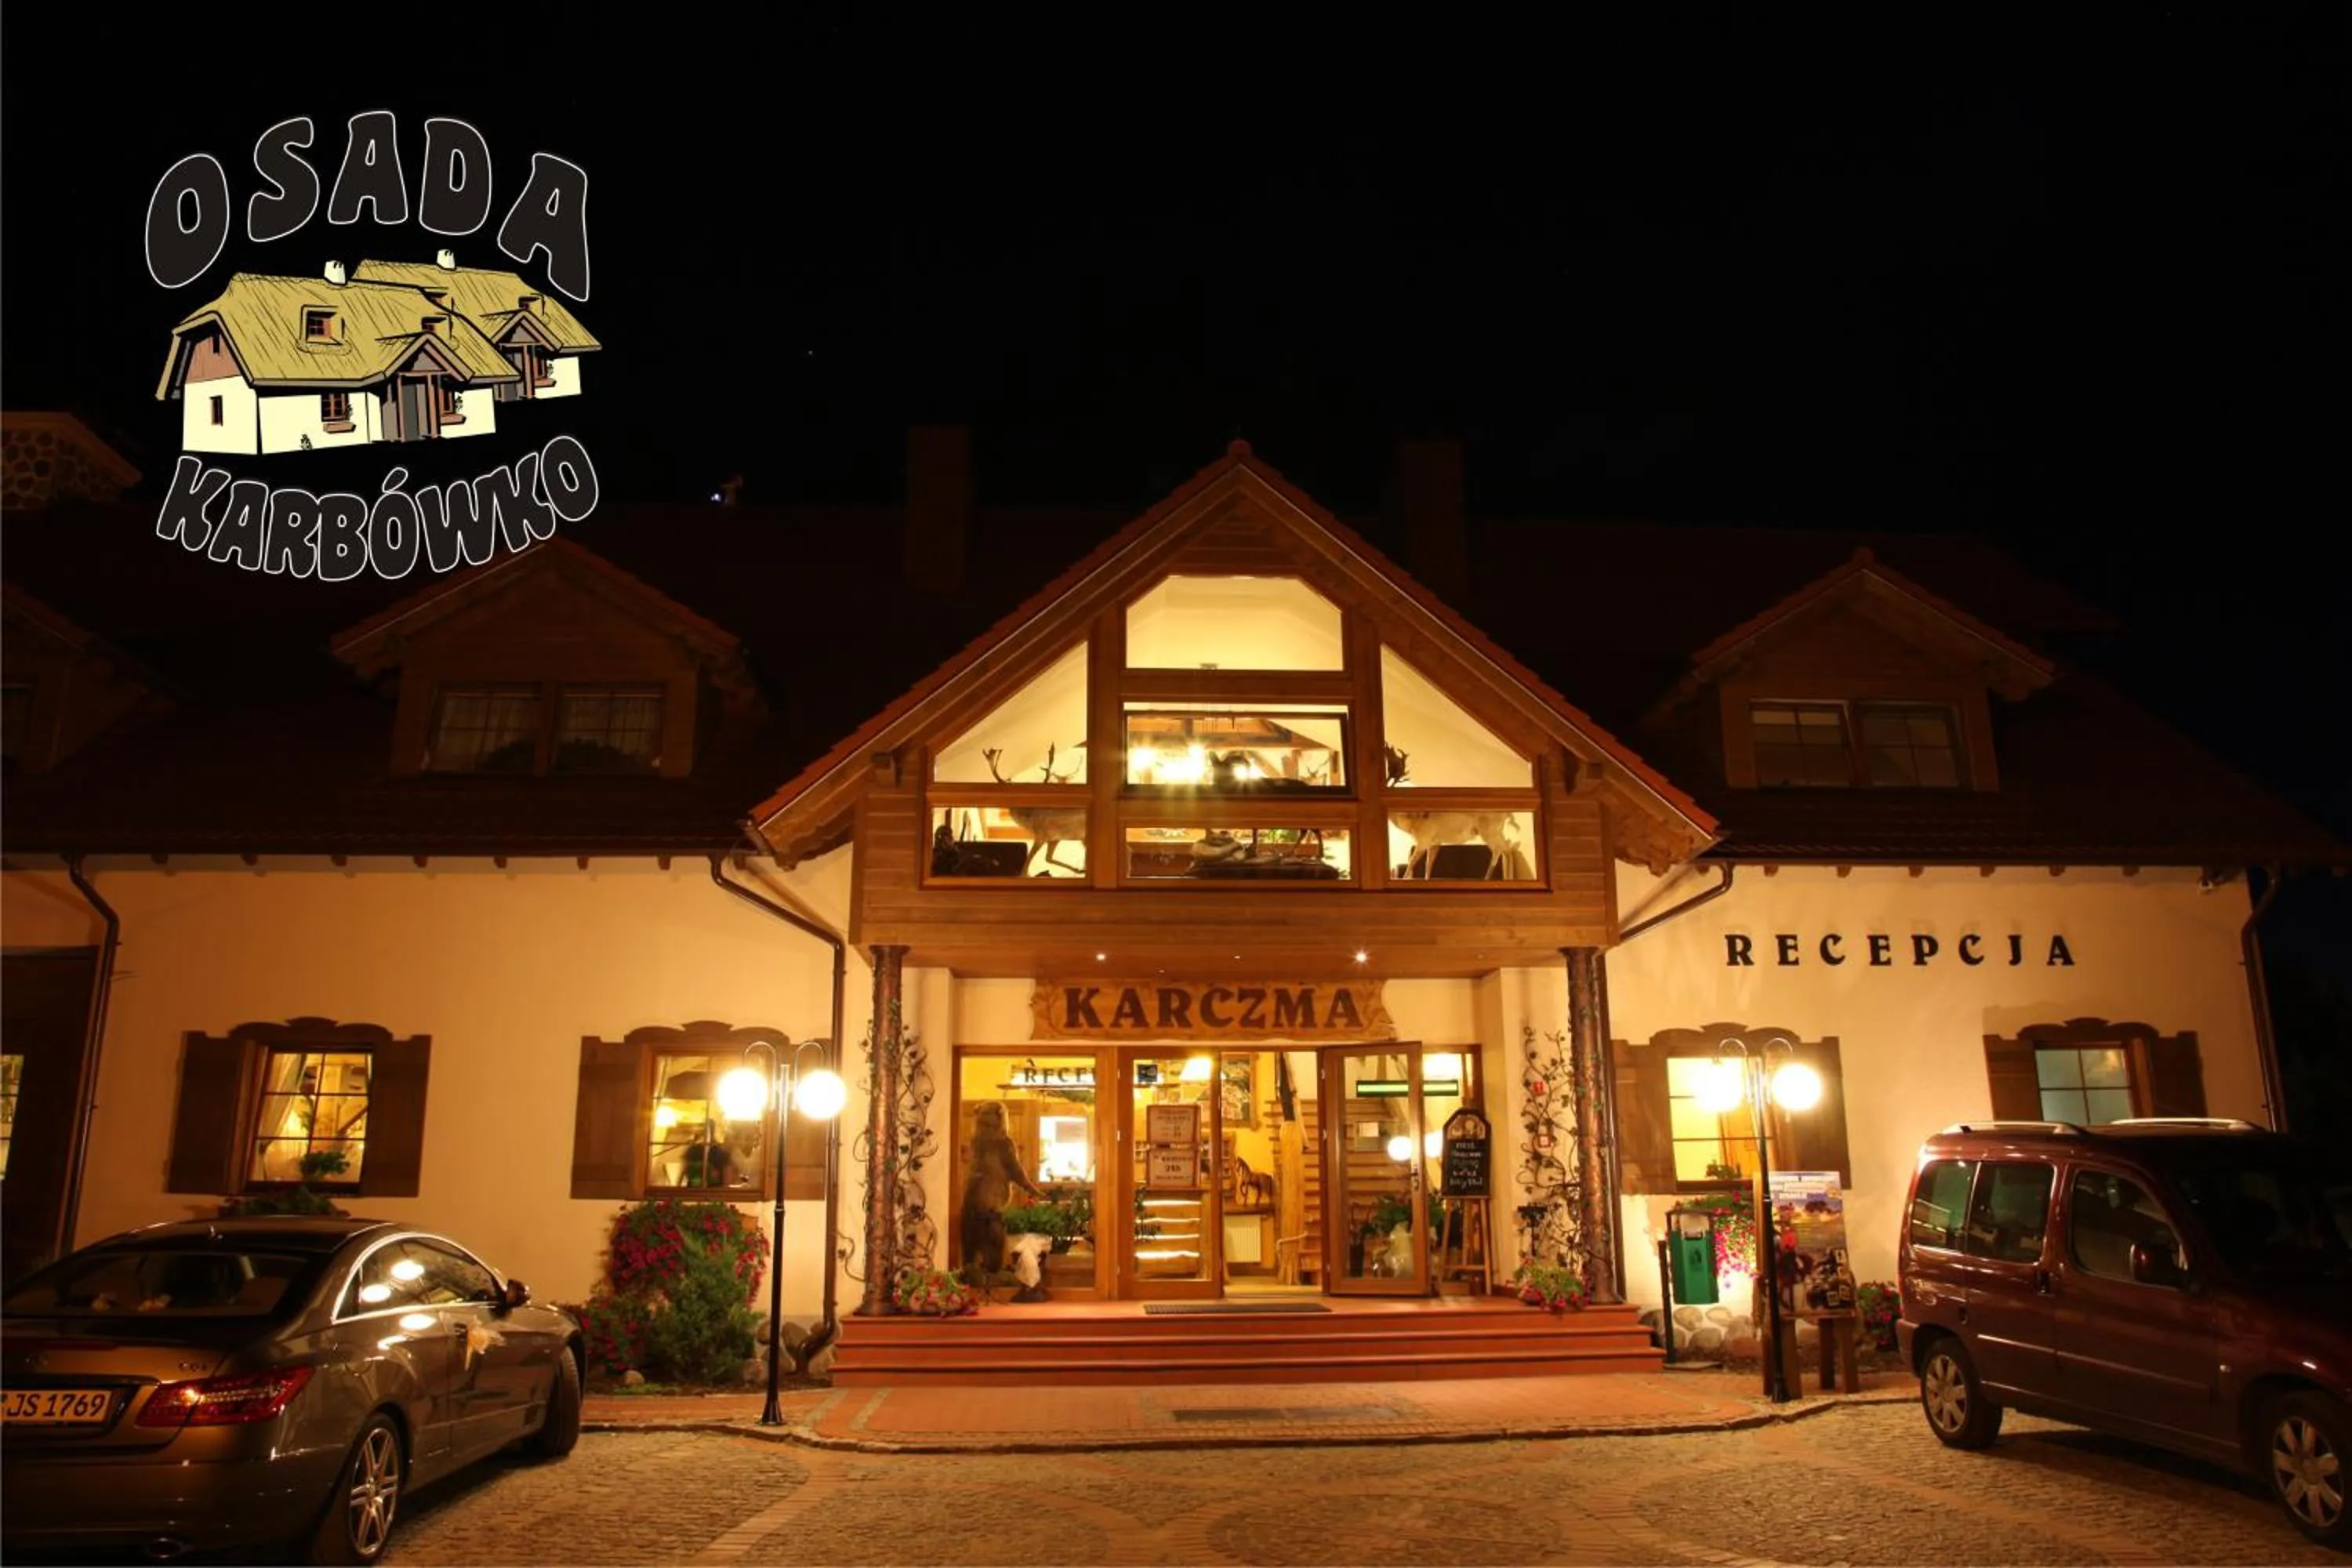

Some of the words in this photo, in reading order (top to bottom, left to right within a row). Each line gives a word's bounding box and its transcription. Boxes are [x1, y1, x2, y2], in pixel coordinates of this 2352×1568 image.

[1725, 934, 2075, 967] RECEPCJA
[1063, 987, 1364, 1029] KARCZMA
[1024, 1067, 1096, 1083] RECE
[44, 1393, 106, 1416] 1769
